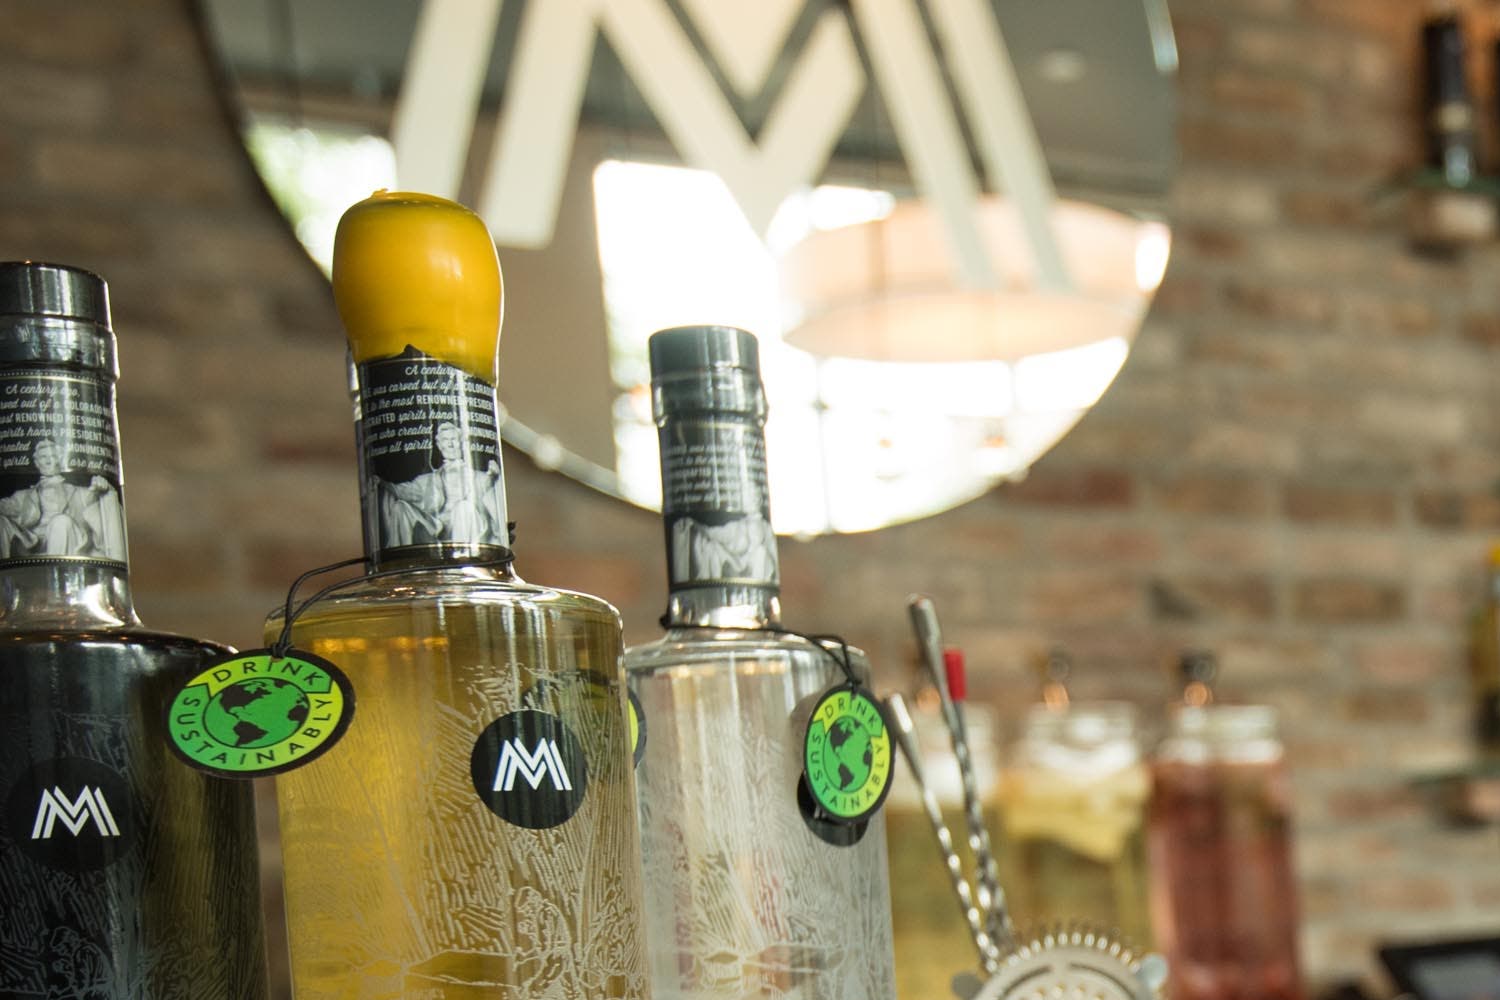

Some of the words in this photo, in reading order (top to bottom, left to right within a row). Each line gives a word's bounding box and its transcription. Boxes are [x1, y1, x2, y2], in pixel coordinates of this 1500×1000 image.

[20, 384, 57, 398] century
[421, 380, 438, 390] out
[440, 379, 450, 393] of
[20, 398, 38, 409] out
[391, 396, 415, 407] most
[416, 394, 463, 405] RENOWNED
[398, 409, 426, 424] spirits
[398, 423, 433, 438] created
[404, 438, 433, 454] spirits
[211, 660, 324, 686] DRINK
[824, 697, 879, 729] DRINK
[176, 696, 333, 766] SUSTAINABLY
[810, 732, 885, 809] SUSTAINABLY
